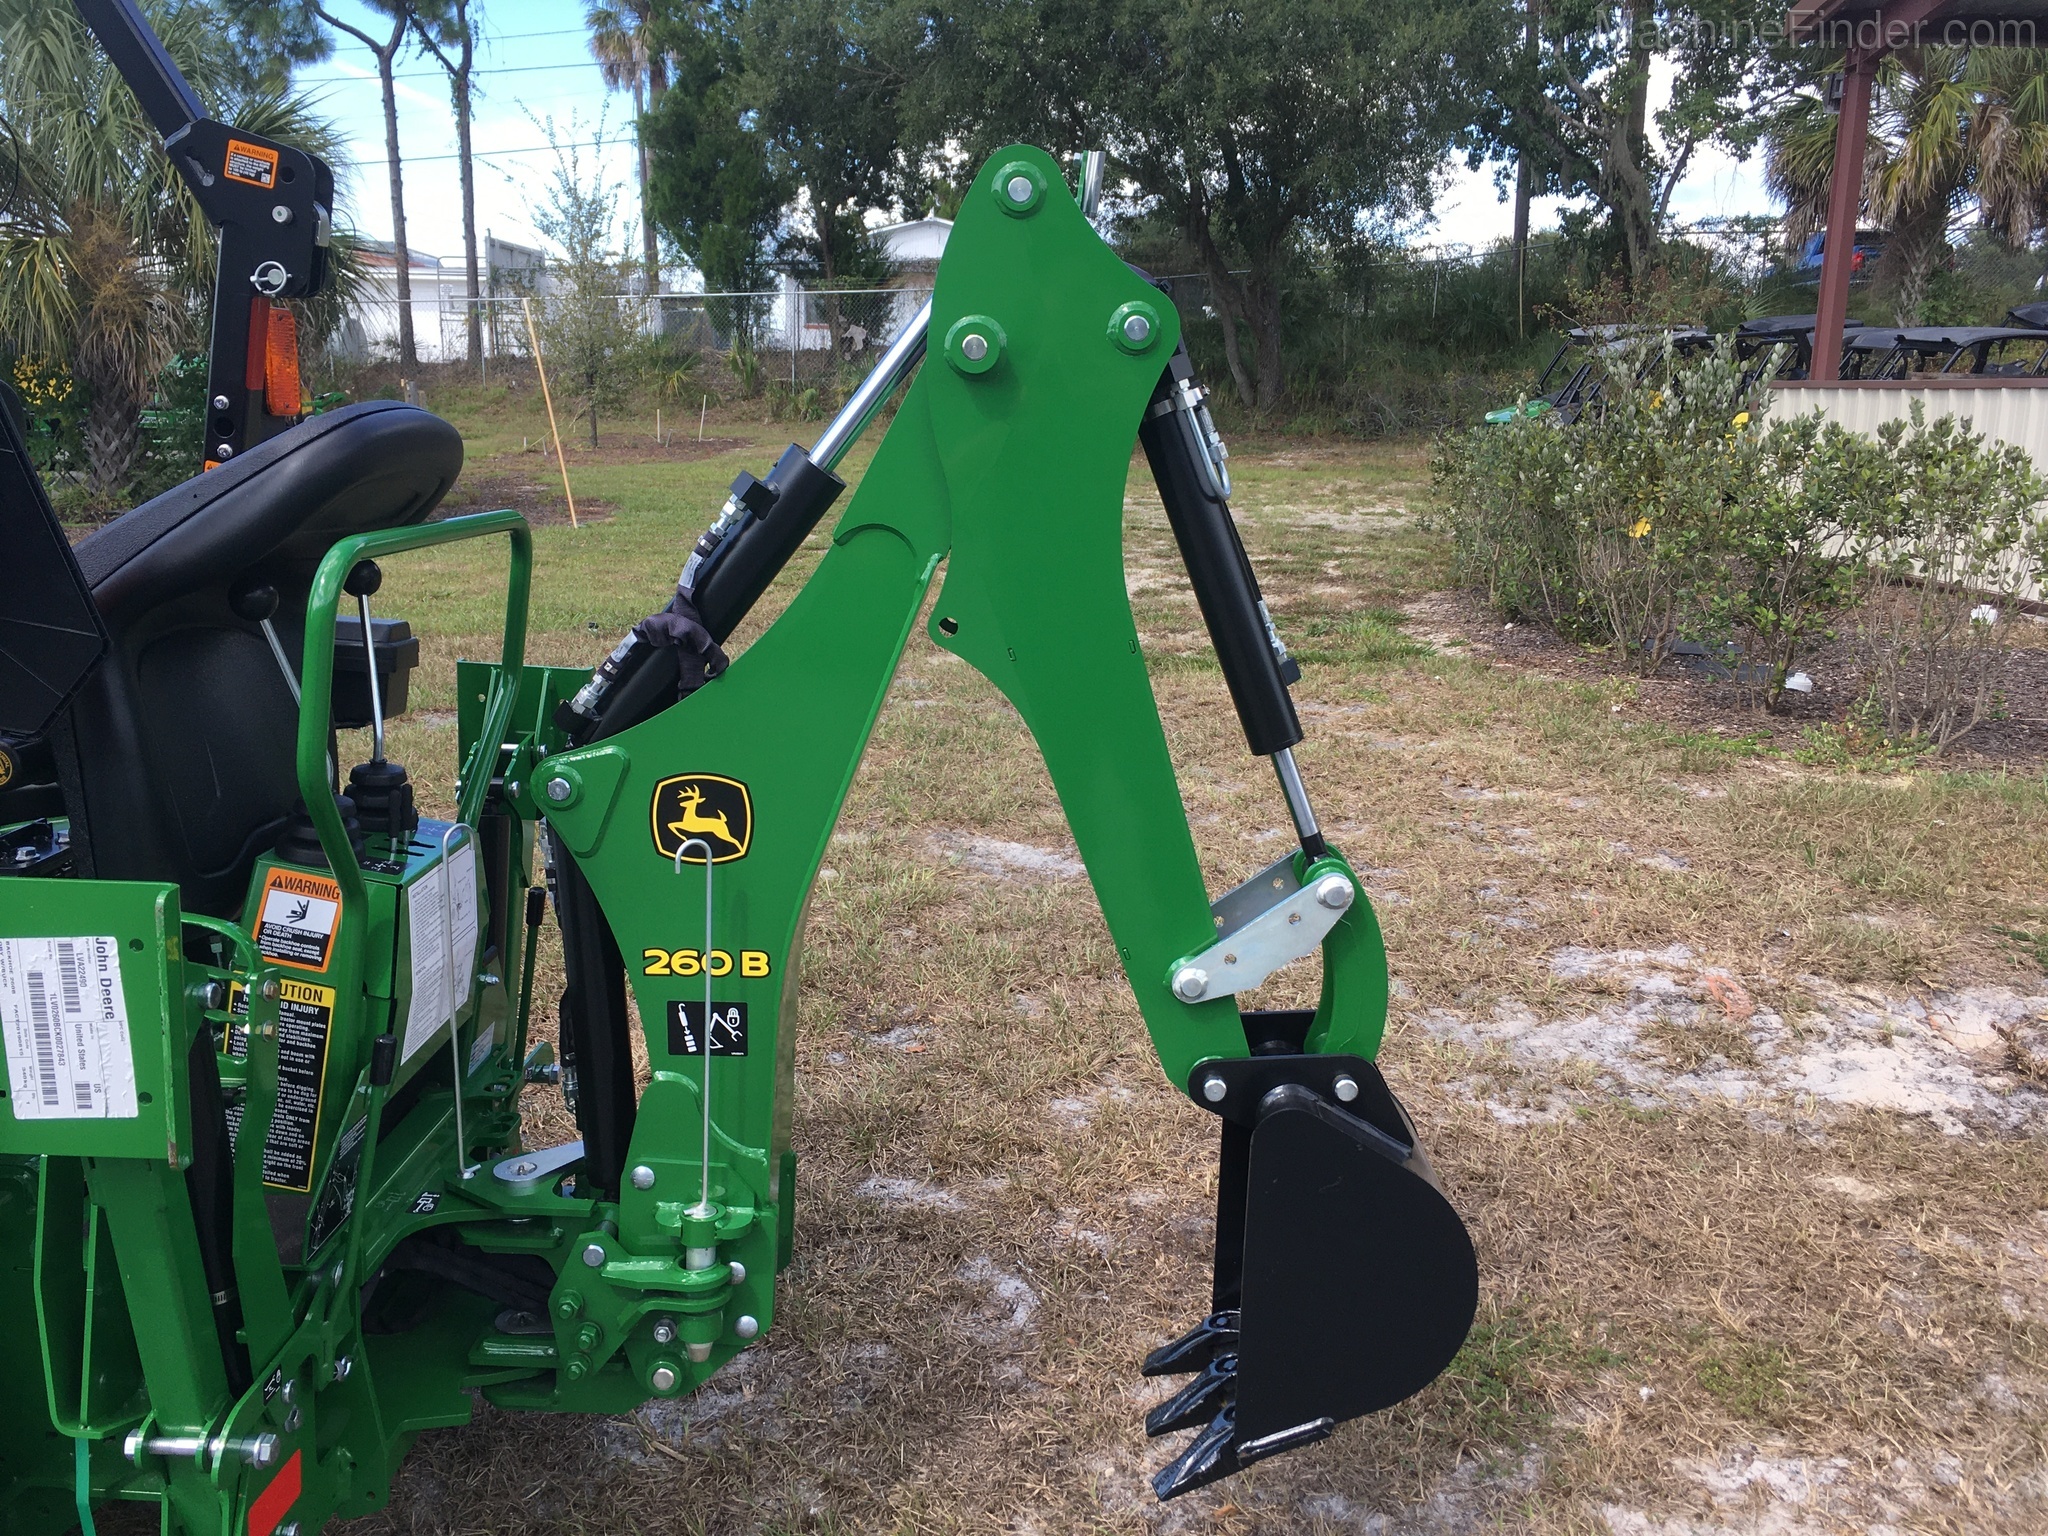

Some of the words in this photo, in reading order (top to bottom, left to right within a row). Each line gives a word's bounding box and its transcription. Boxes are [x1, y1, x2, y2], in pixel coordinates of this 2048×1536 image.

[240, 145, 274, 160] WARNING
[285, 876, 340, 899] WARNING
[283, 927, 302, 935] CRUSH
[303, 930, 324, 939] INJURY
[95, 938, 109, 971] John
[642, 948, 734, 977] 260
[740, 949, 771, 978] B
[76, 953, 87, 987] LVA22490
[100, 978, 115, 1019] Deere
[280, 983, 323, 1003] UTION
[290, 1003, 319, 1015] INJURY
[75, 1024, 84, 1047] United
[78, 1049, 86, 1070] States
[94, 1084, 101, 1093] US
